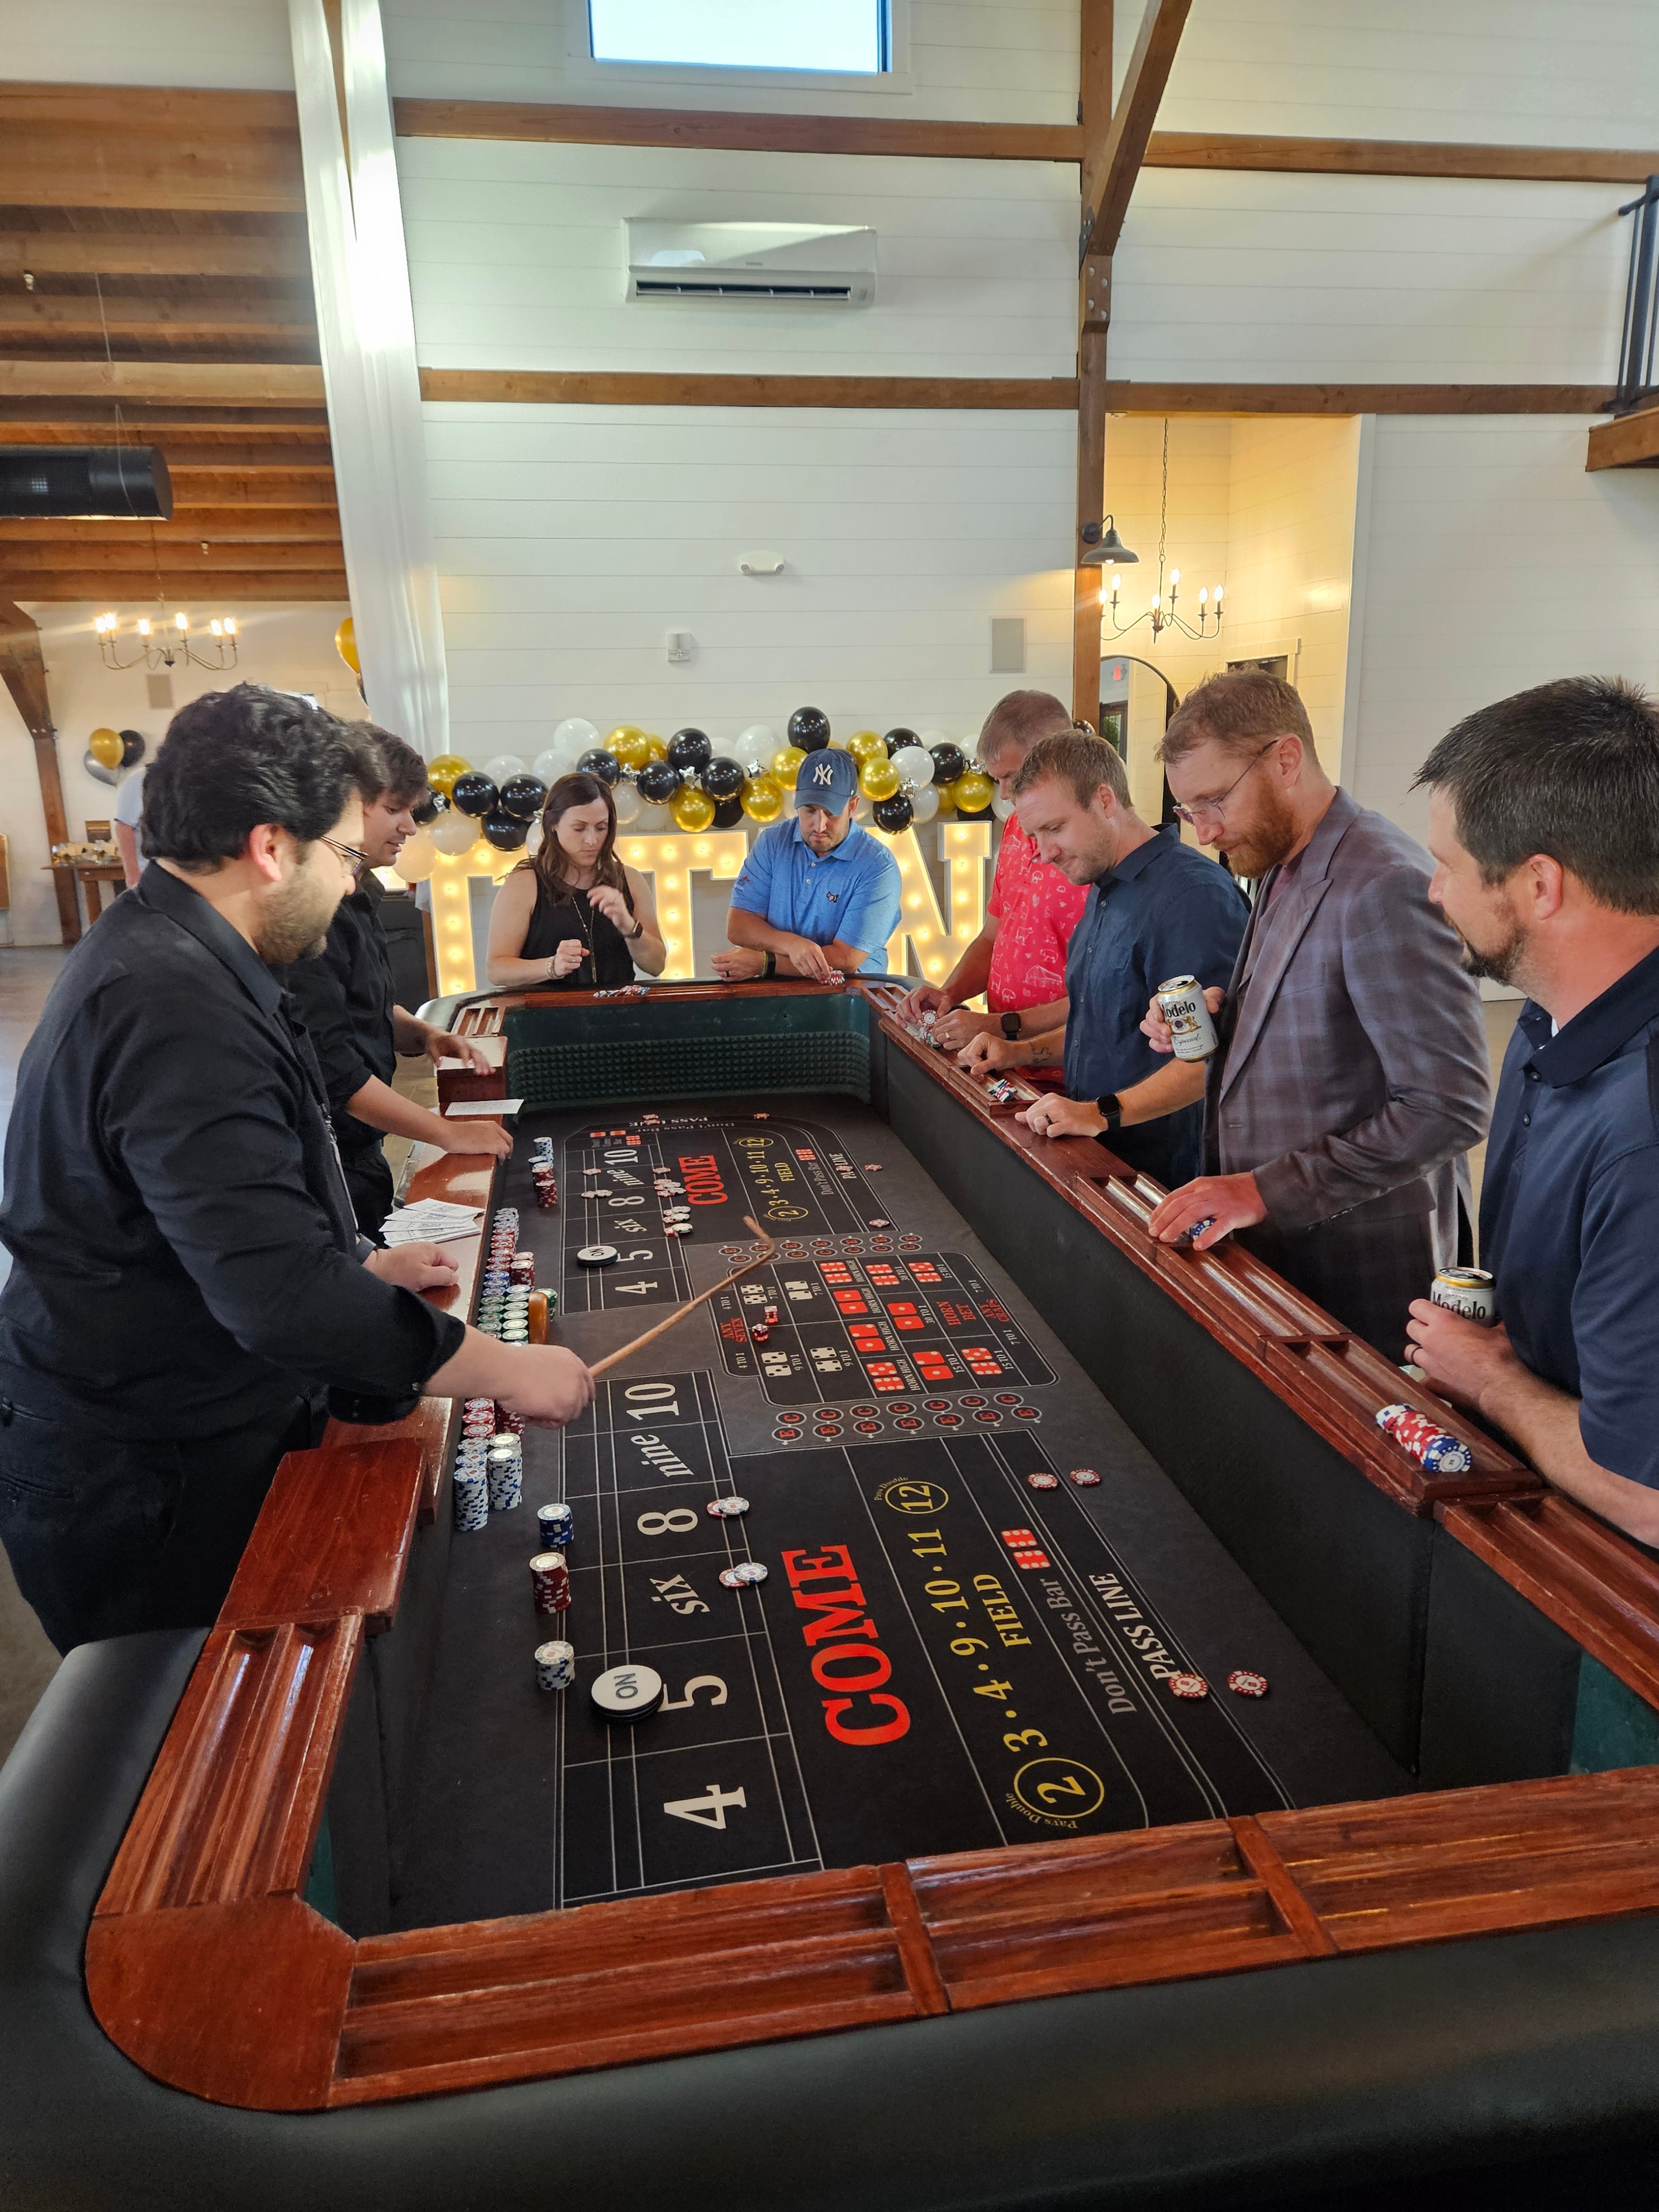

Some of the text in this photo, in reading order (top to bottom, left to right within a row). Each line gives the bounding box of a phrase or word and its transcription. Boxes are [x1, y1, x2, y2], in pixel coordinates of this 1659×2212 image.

[747, 1138, 764, 1146] 12
[604, 1149, 638, 1165] 10
[747, 1150, 765, 1159] 11
[829, 1153, 849, 1165] LINE
[749, 1164, 769, 1173] 10
[774, 1162, 795, 1181] FIELD
[607, 1169, 645, 1186] nine
[678, 1155, 729, 1205] COME
[608, 1196, 645, 1207] 8
[614, 1218, 647, 1233] six
[616, 1250, 653, 1262] 5
[615, 1281, 658, 1294] 4
[867, 1300, 881, 1313] HORN
[920, 1309, 931, 1317] TO
[937, 1301, 962, 1325] HORN
[956, 1304, 977, 1321] BET
[877, 1321, 900, 1351] HORN HIGH
[1005, 1334, 1018, 1342] TO
[791, 1358, 802, 1366] TO
[948, 1358, 960, 1366] TO
[996, 1354, 1009, 1362] TO
[896, 1359, 921, 1391] HORN HIGH
[624, 1383, 679, 1421] 10
[784, 1414, 800, 1422] C
[940, 1416, 957, 1425] E
[979, 1412, 996, 1421] E
[1017, 1409, 1034, 1417] E
[820, 1426, 836, 1434] E
[860, 1423, 877, 1431] E
[900, 1419, 918, 1428] E
[779, 1429, 795, 1438] E
[630, 1434, 694, 1478] nine
[874, 1476, 908, 1501] Pays Double
[637, 1508, 698, 1536] 8
[650, 1574, 710, 1615] six
[974, 1574, 1032, 1647] FIELD
[1089, 1573, 1181, 1680] PASS LINE
[781, 1544, 911, 1746] COME
[899, 1486, 1086, 1804] 2 3 4 9 10 11 12
[1040, 1578, 1137, 1714] Don't Pass Bar
[614, 1673, 638, 1699] ON
[657, 1675, 729, 1713] 5
[664, 1784, 747, 1830] 4
[1005, 1793, 1078, 1828] Pays Double
